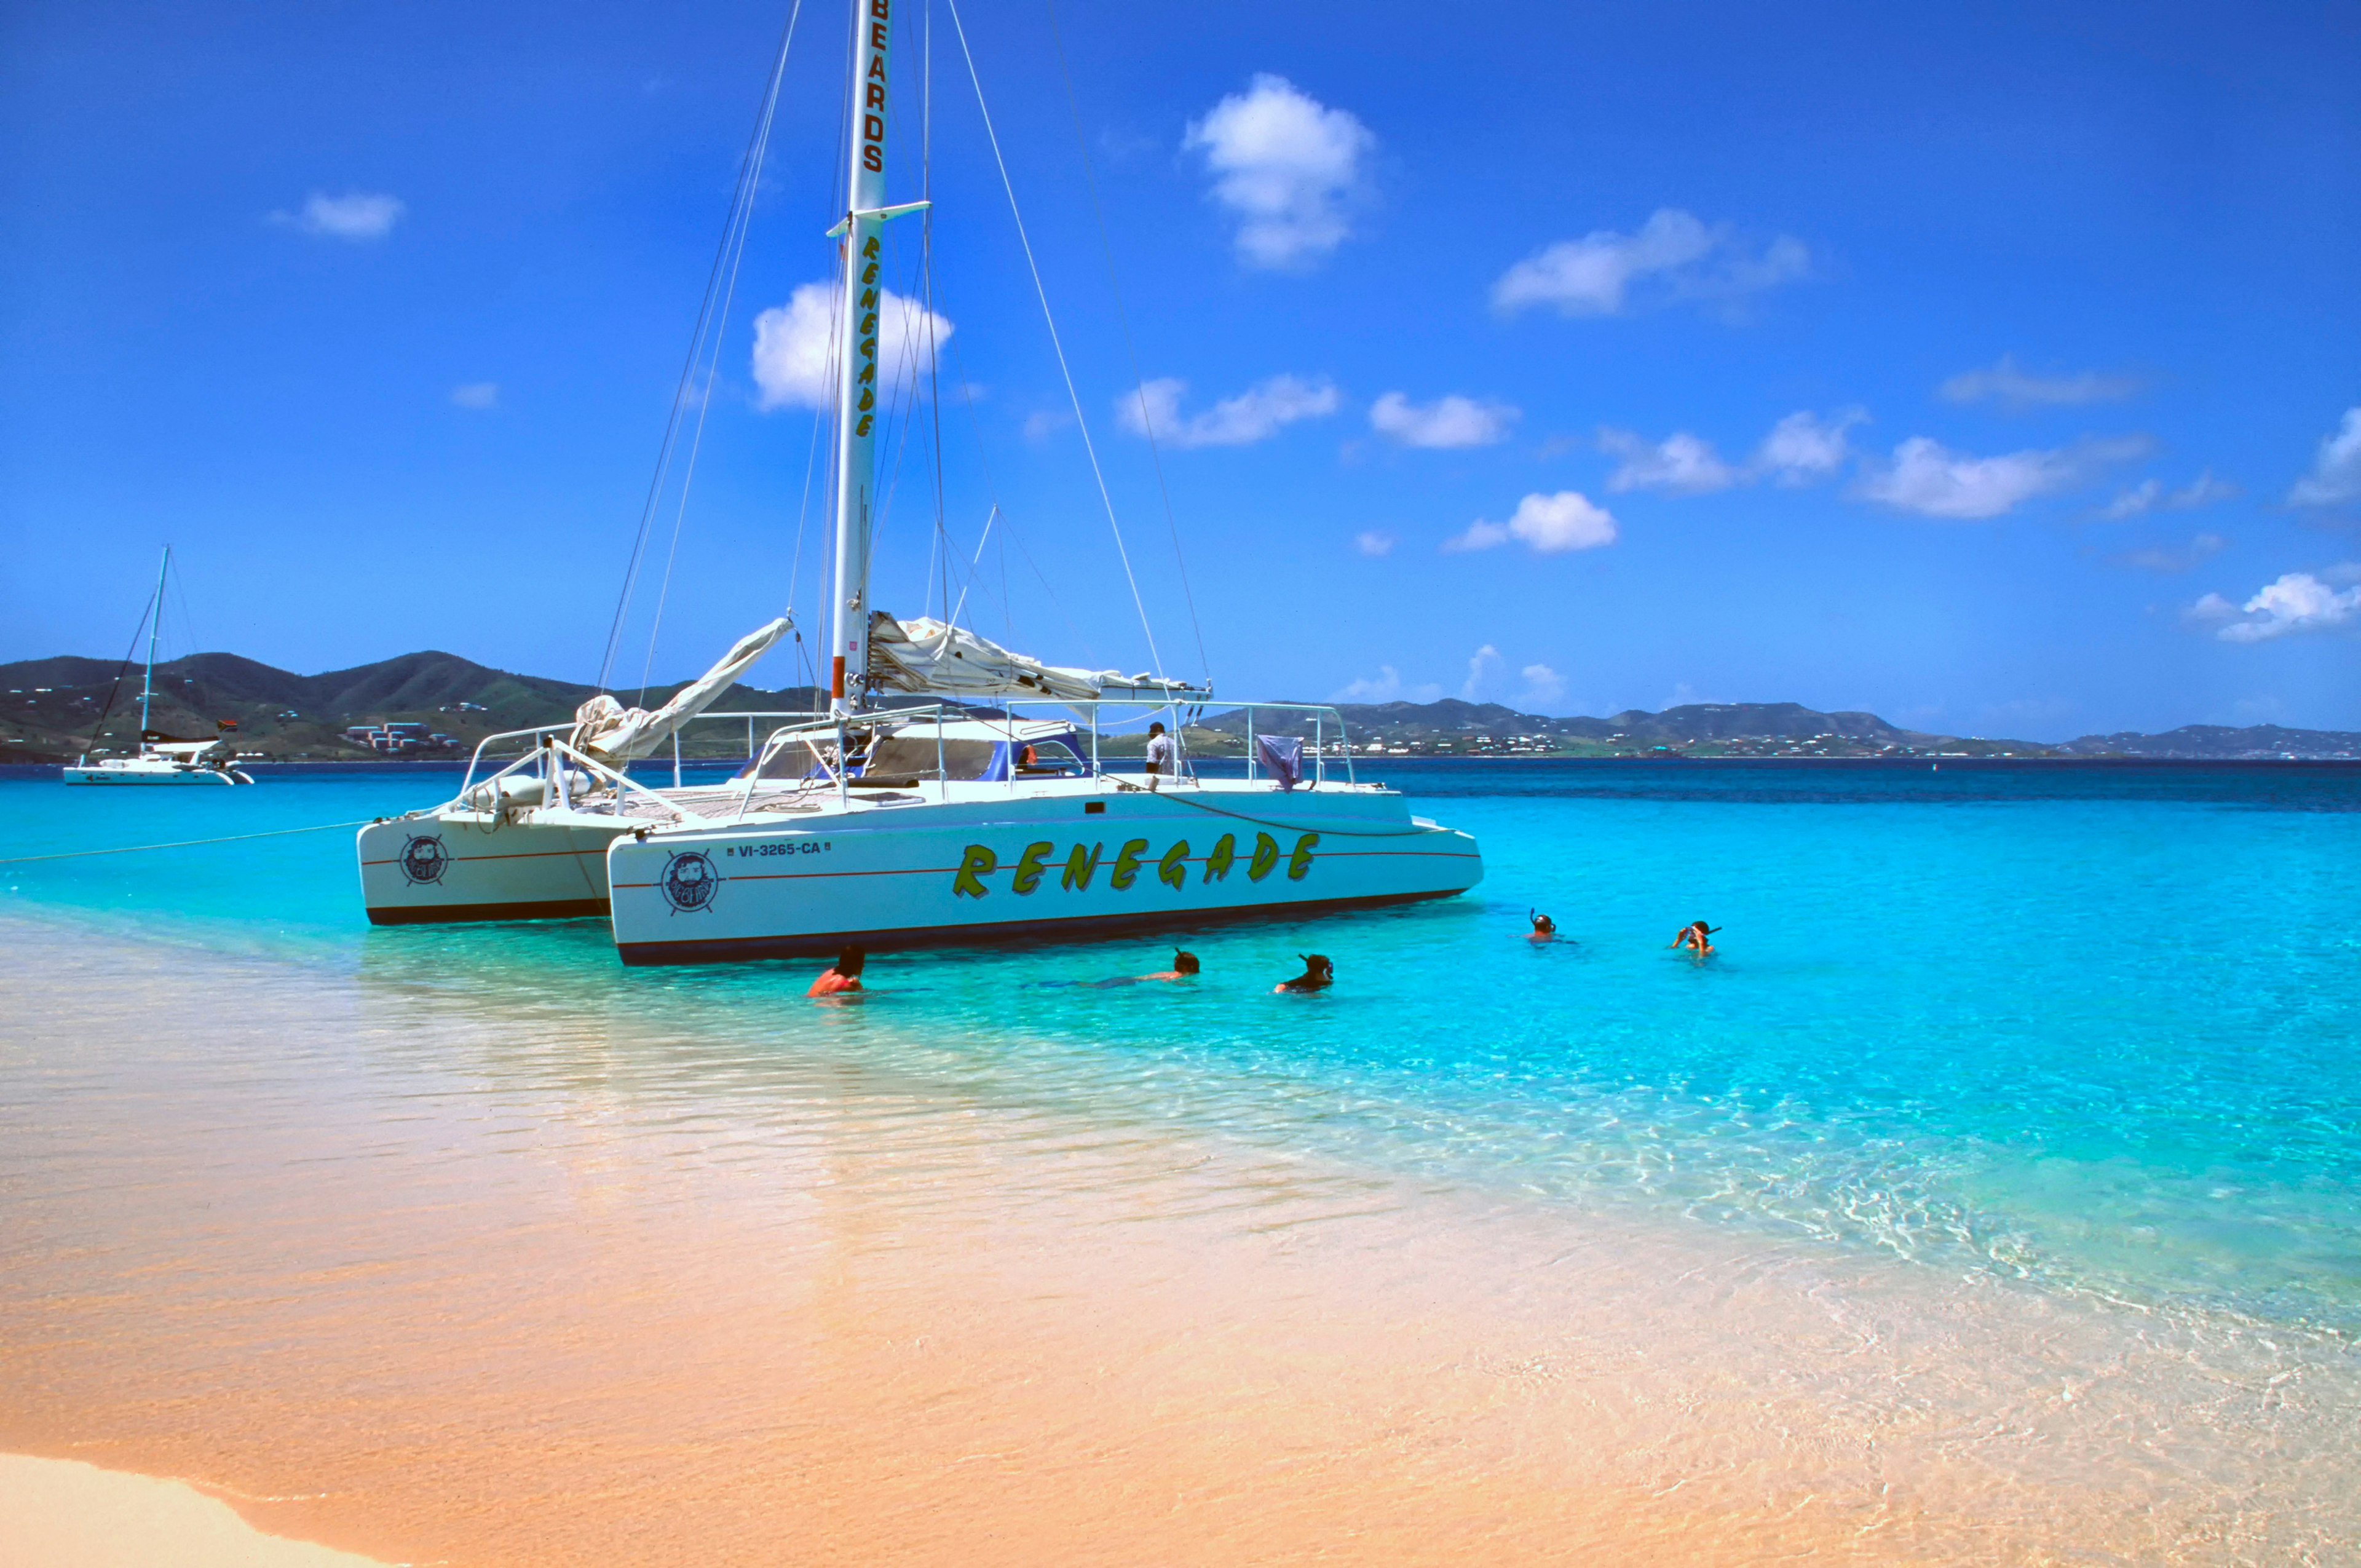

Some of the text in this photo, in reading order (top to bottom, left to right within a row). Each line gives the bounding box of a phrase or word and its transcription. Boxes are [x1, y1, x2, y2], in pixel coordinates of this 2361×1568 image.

[863, 0, 888, 173] BEARDS
[856, 236, 879, 437] RENEGADE
[739, 842, 821, 857] VI-3265-CA
[953, 831, 1319, 898] RENEGADE
